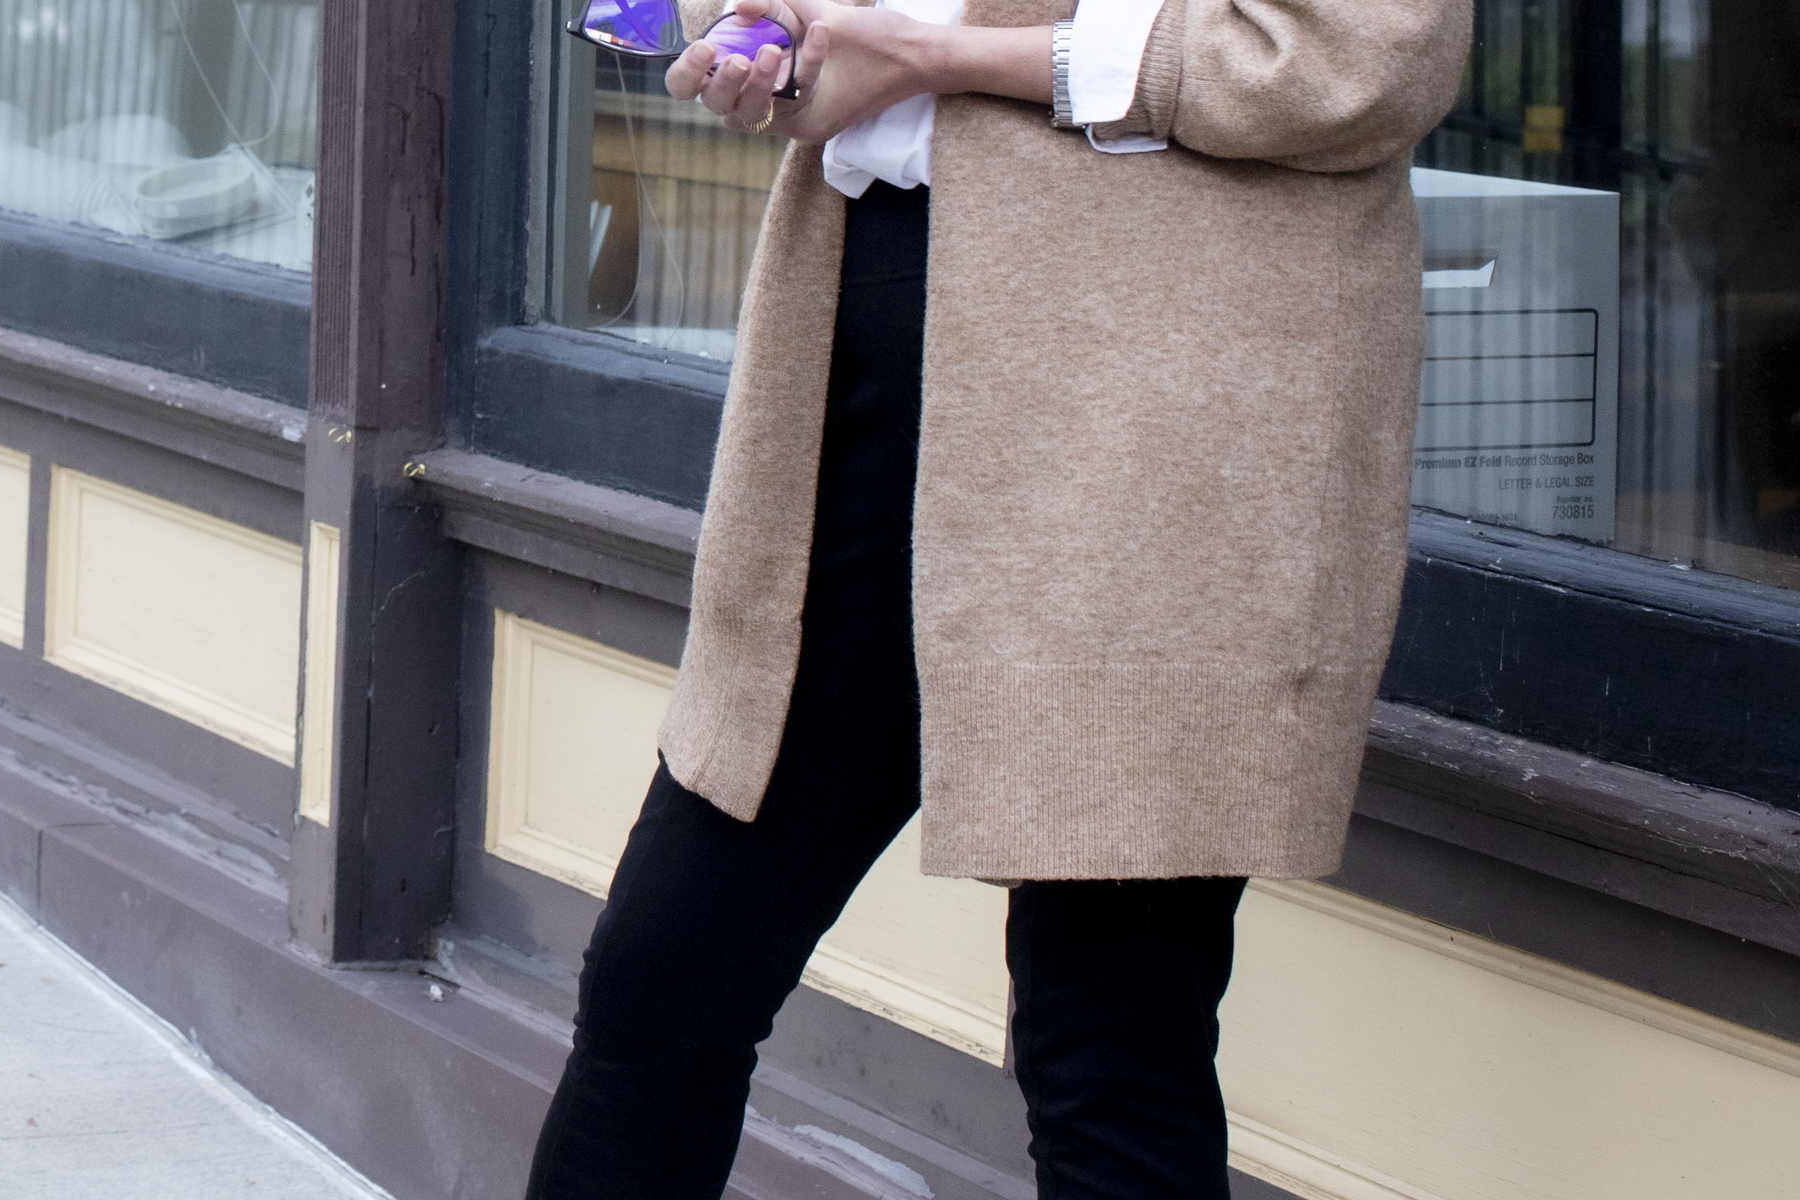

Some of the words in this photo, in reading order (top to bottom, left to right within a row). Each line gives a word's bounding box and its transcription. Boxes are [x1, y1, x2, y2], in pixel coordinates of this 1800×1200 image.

[1414, 457, 1462, 469] Premium
[1464, 455, 1477, 468] EZ
[1479, 455, 1502, 468] Fold
[1504, 454, 1537, 467] Record
[1539, 453, 1574, 468] Storage
[1576, 452, 1595, 465] Box
[1499, 478, 1532, 490] LETTER
[1535, 478, 1542, 489] &
[1544, 476, 1572, 488] LEGAL
[1574, 475, 1595, 487] SIZE
[1552, 504, 1595, 519] 730815
